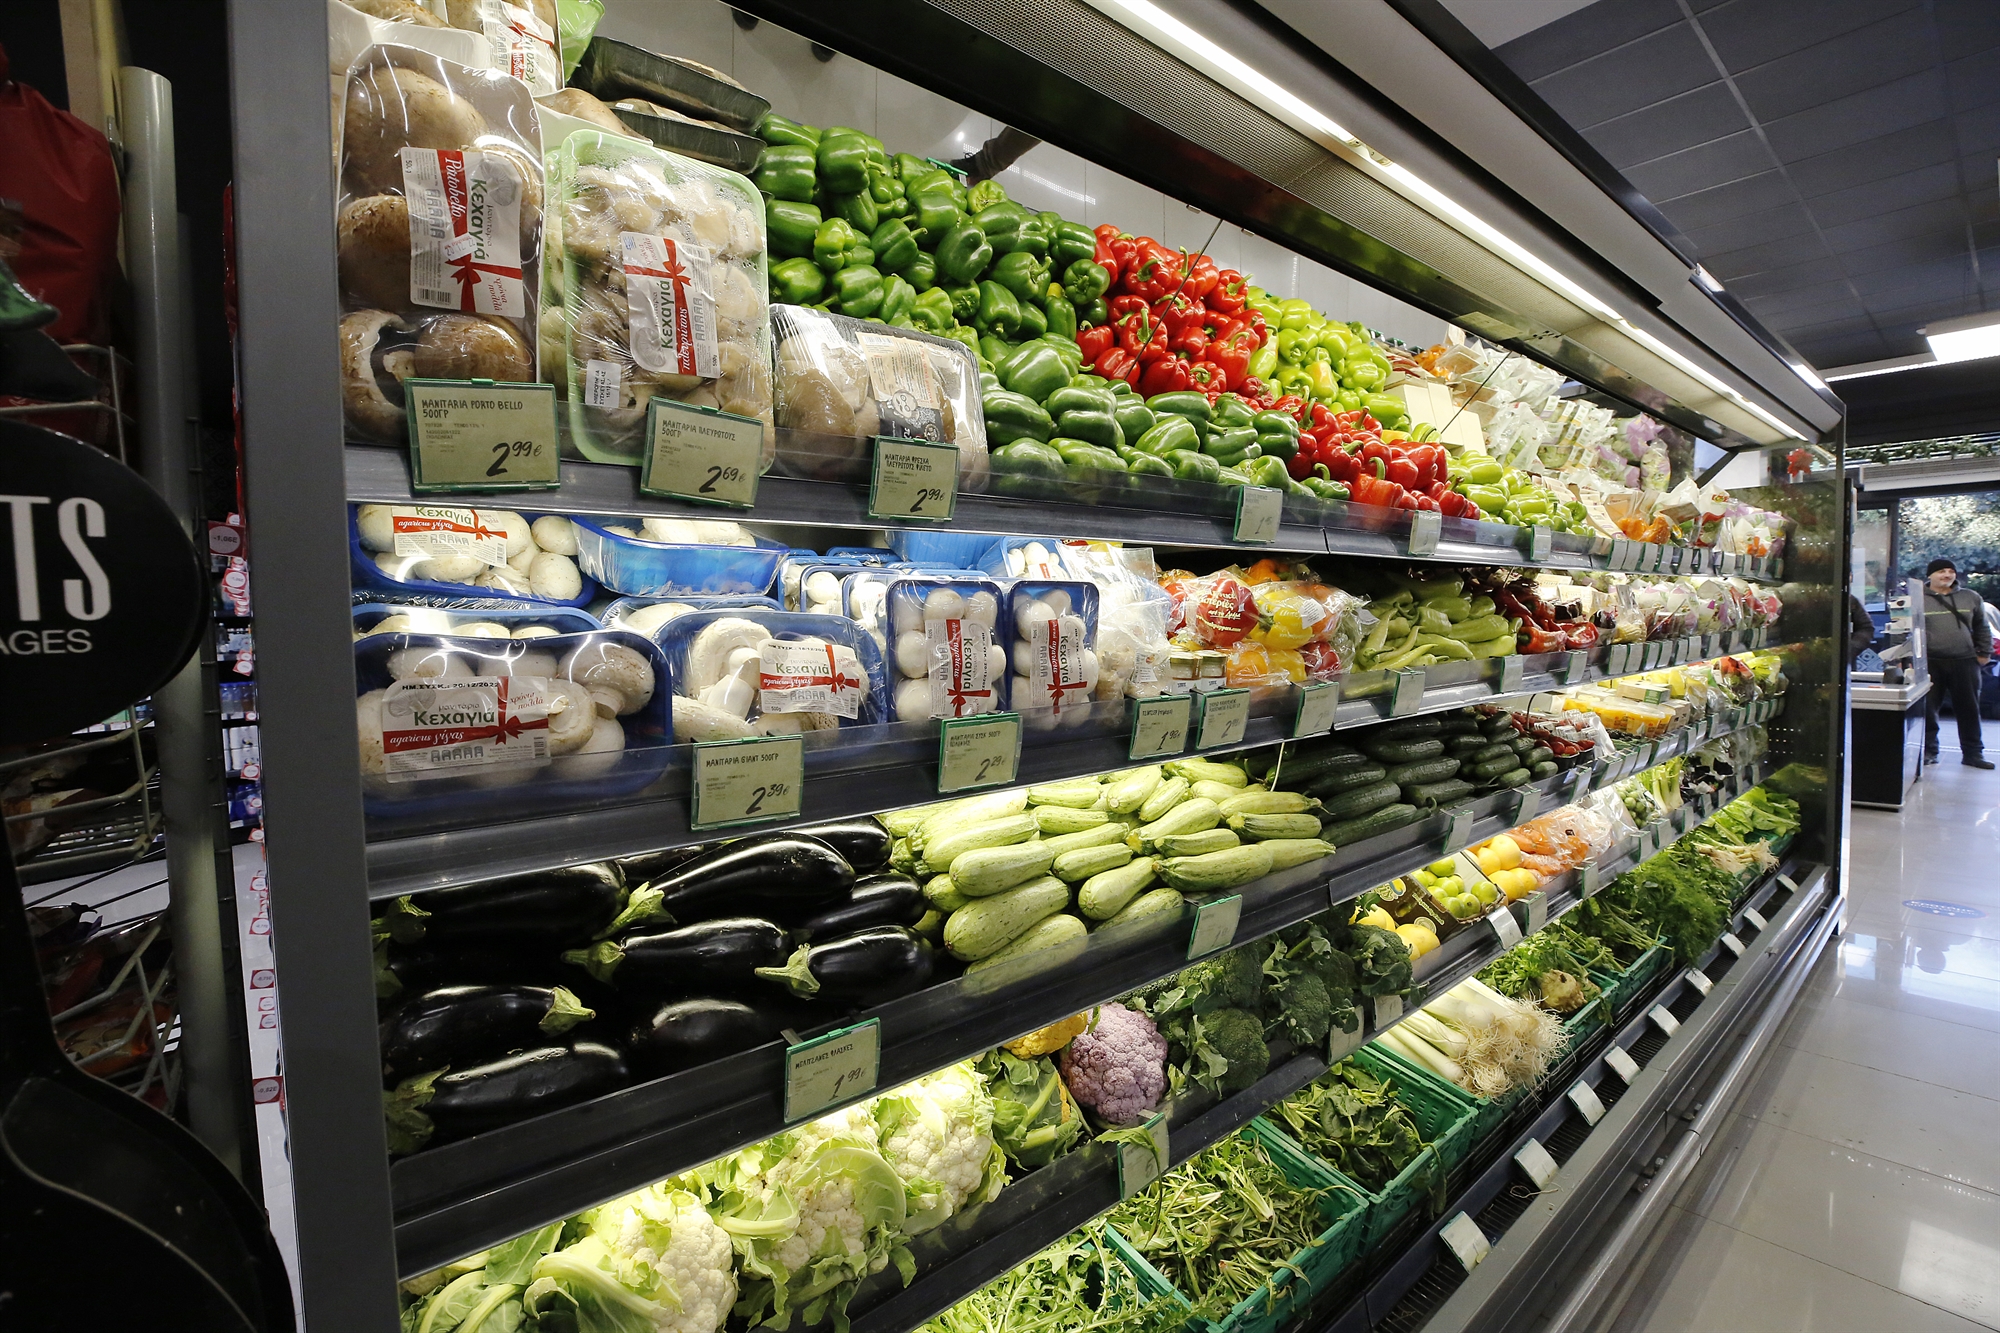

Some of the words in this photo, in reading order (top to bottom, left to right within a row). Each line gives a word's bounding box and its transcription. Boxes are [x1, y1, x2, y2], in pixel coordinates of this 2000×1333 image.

[444, 157, 467, 218] Portobello
[657, 280, 674, 350] Κεχαγιά
[422, 399, 468, 409] ΜΑΝΙΤΑΡΙΑ
[662, 420, 697, 433] ΜΑΝΙΤΑΡΙΑ
[698, 426, 736, 441] ΠΛΕΥΡΩΤΟΥΣ
[884, 454, 910, 463] ΜΑΝΙΤΑΡΙΑ
[911, 456, 930, 465] ΦΡΕΣΚΑ
[415, 505, 472, 525] Κεχαγιά
[962, 638, 973, 689] Κεχαγιά
[1060, 635, 1071, 683] Κεχαγιά
[776, 663, 830, 675] Κεχαγιά
[414, 708, 495, 726] Κεχαγιά
[390, 735, 432, 747] agaricus
[434, 729, 465, 746] γίγας
[706, 757, 740, 767] ΜΑΝΙΤΑΡΙΑ
